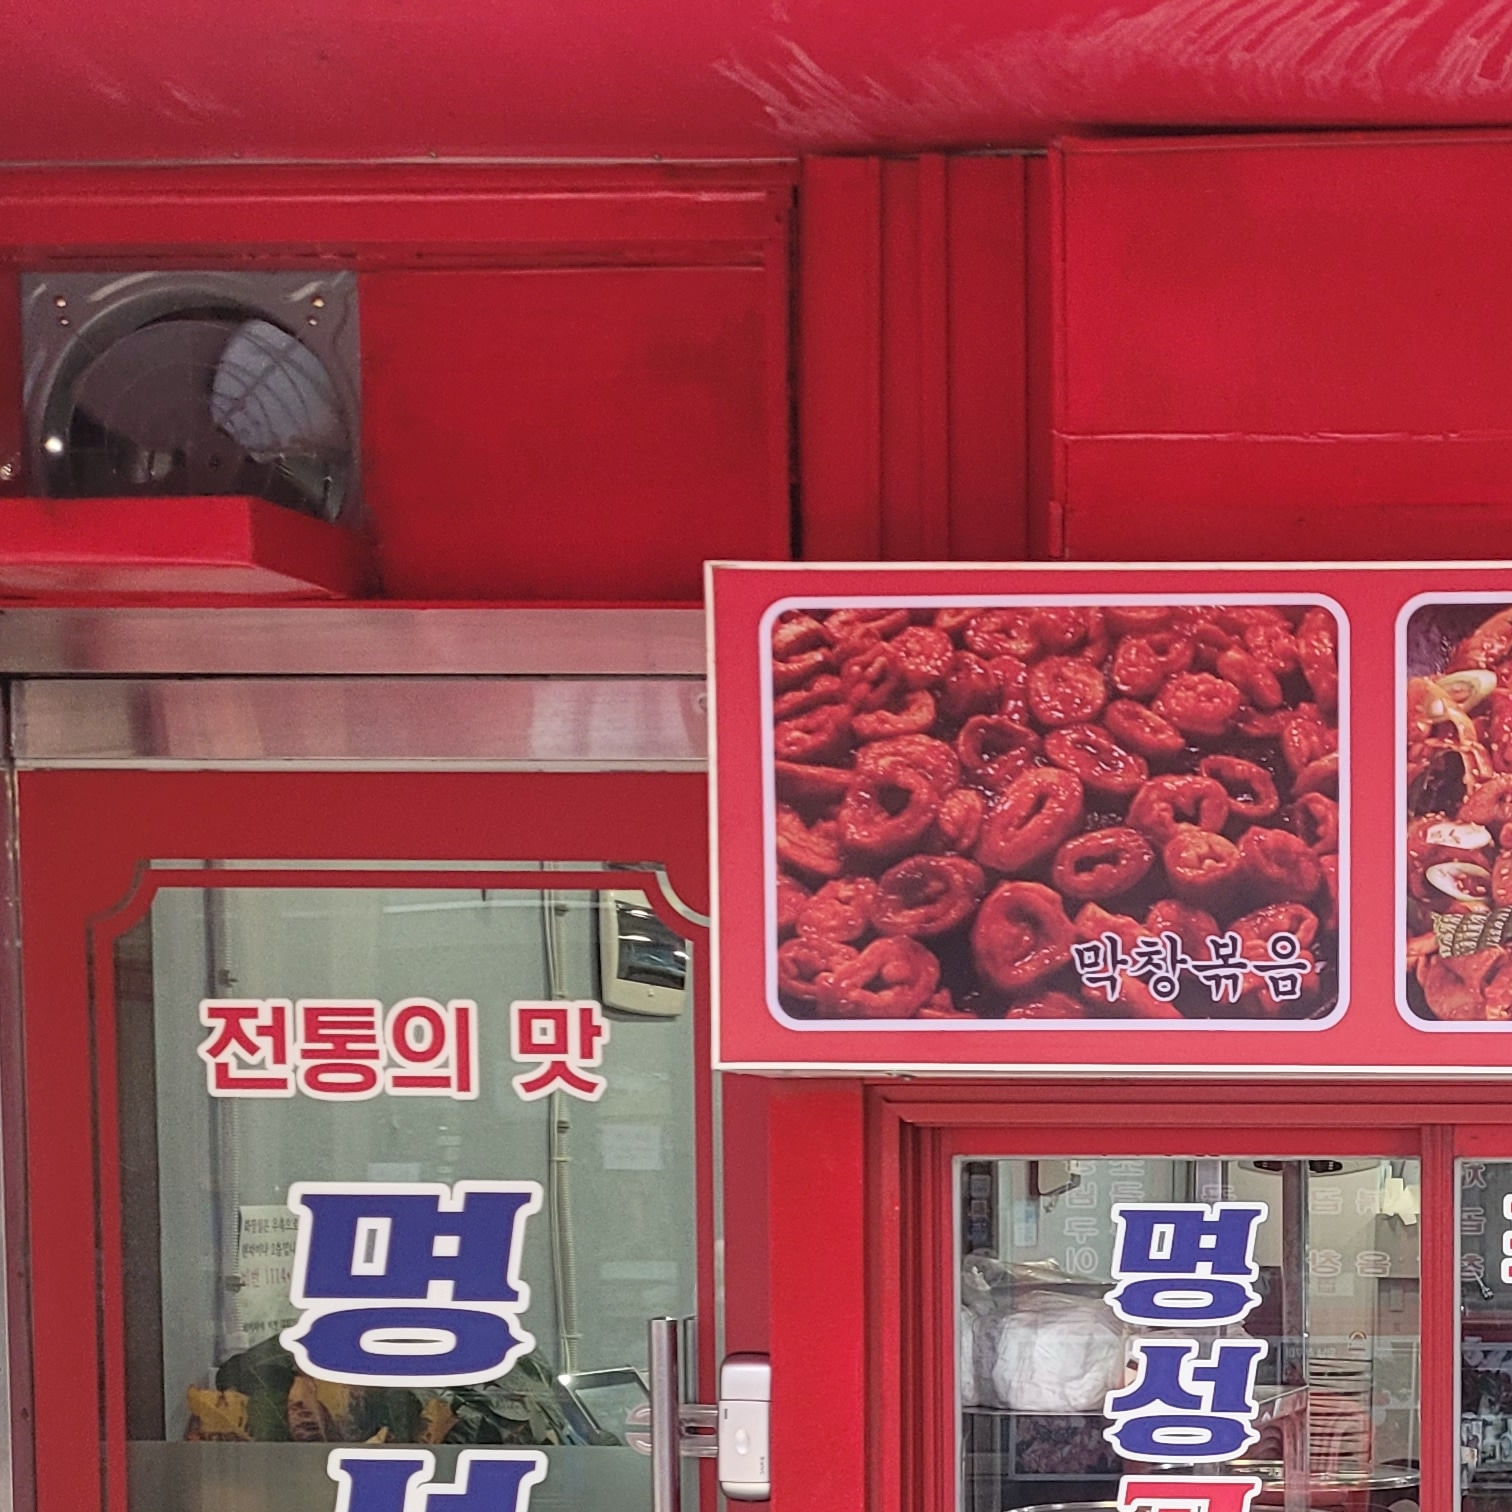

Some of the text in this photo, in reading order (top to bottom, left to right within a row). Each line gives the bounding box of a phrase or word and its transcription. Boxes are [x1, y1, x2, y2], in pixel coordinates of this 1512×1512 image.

[1070, 932, 1312, 1003] 막창볶음
[197, 998, 610, 1101] 전통의 맛
